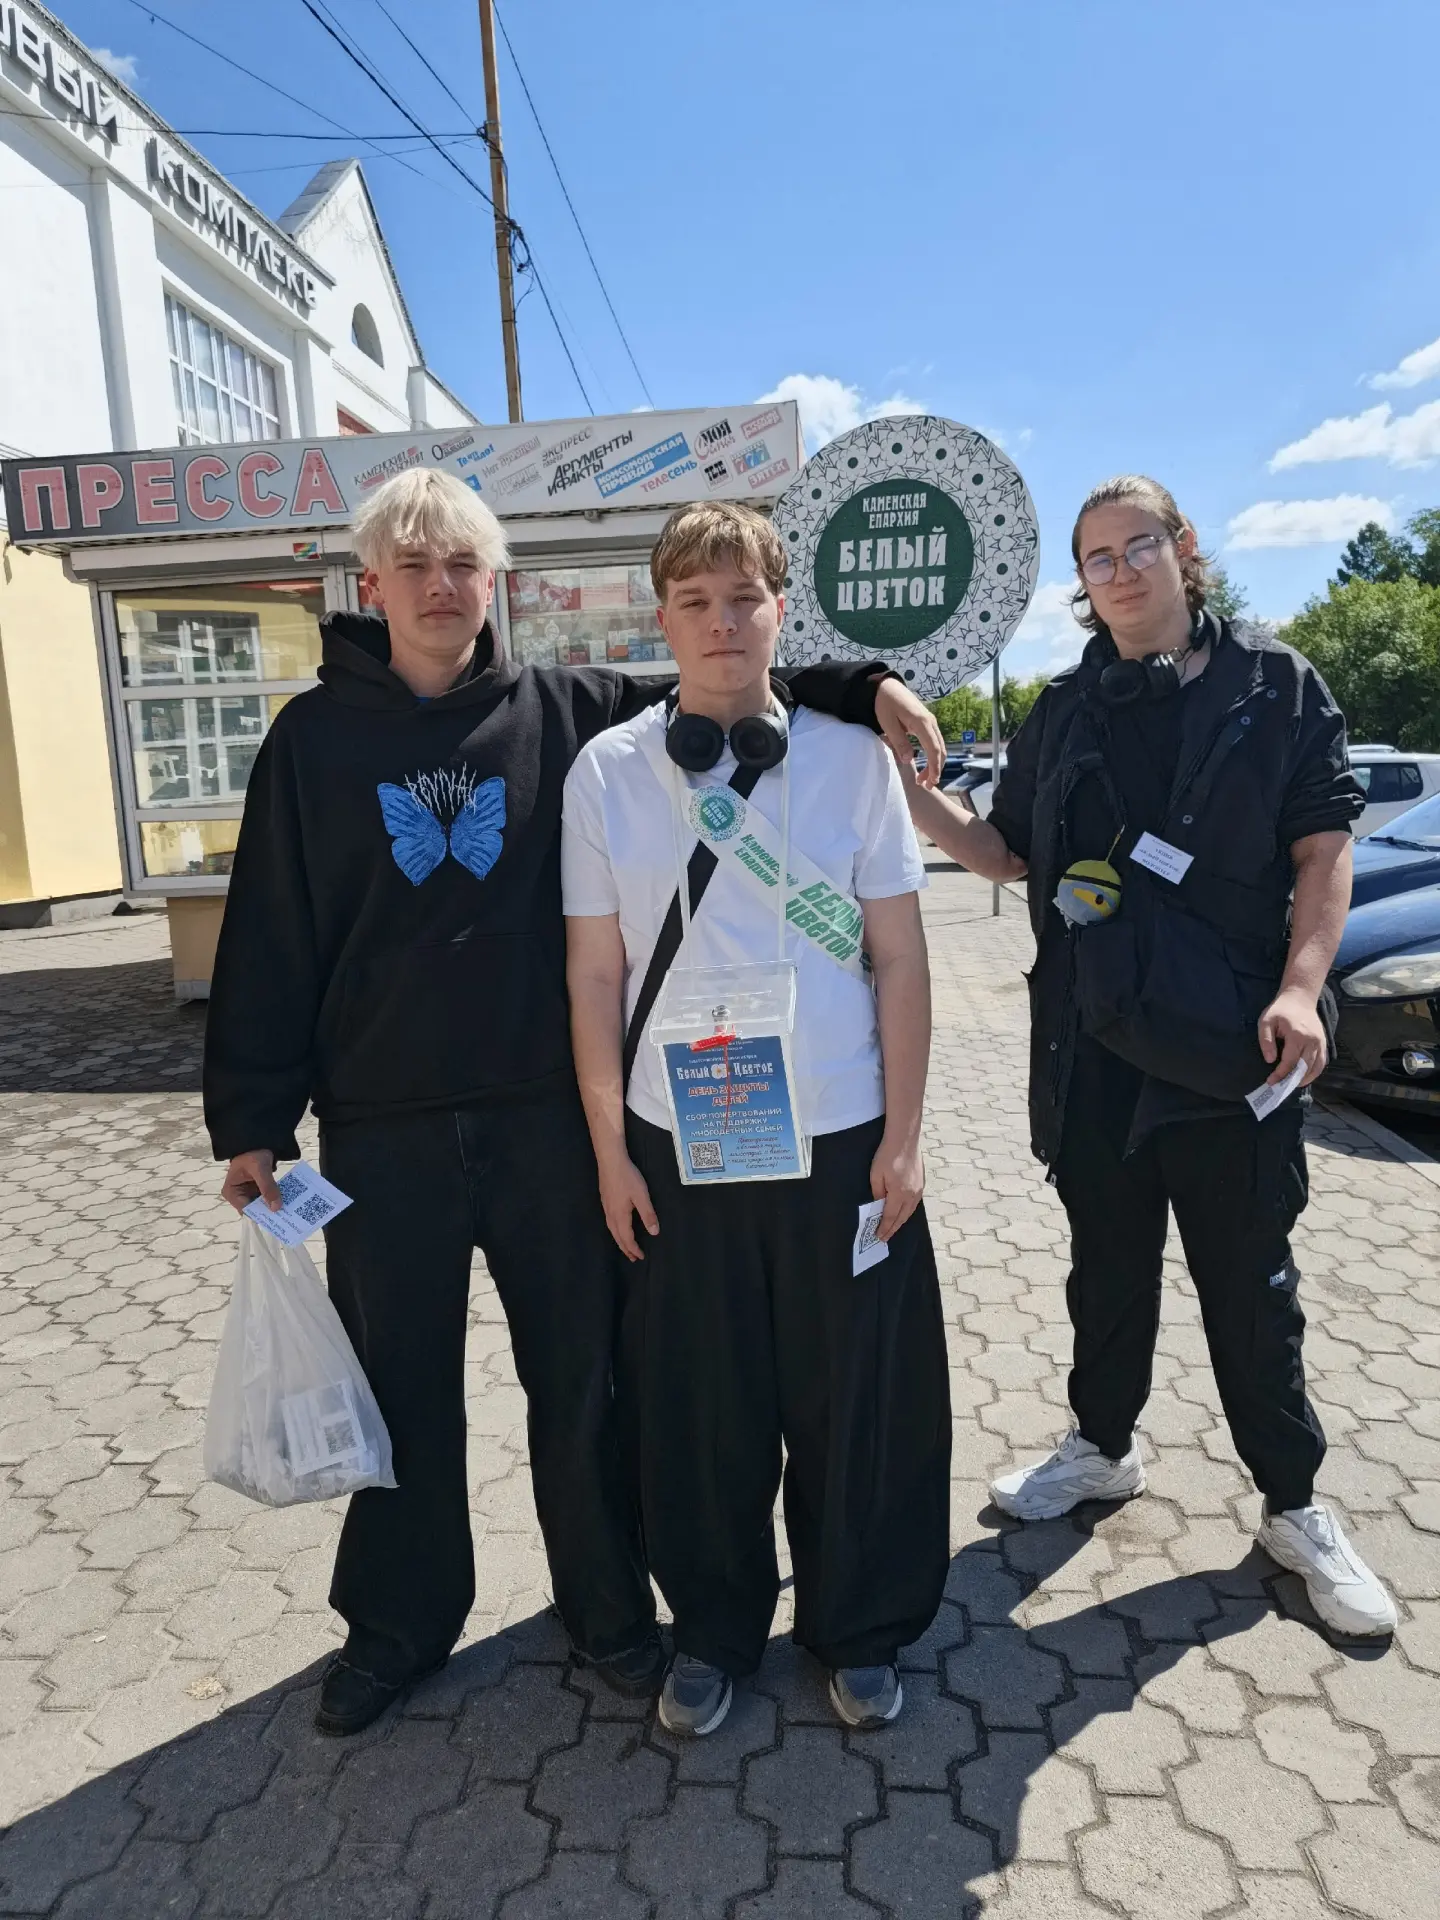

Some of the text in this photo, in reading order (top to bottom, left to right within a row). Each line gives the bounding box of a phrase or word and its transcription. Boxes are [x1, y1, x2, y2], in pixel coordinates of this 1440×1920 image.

[147, 136, 318, 311] КОМПЛЕКС
[541, 426, 594, 460] ЭКСПРЕСС
[701, 420, 732, 447] МОЯ
[554, 430, 633, 484] АРГУМЕНТЫ
[598, 436, 684, 484] КОМСОМОЛЬСКАЯ
[18, 448, 348, 532] ПРЕССА
[600, 460, 656, 494] ПРАВДА
[862, 492, 927, 513] КАМЕНСКАЯ
[868, 509, 920, 530] ЕПАРХИЯ
[838, 525, 948, 573] БЕЛЫЙ
[836, 575, 946, 613] ЦВЕТОК
[688, 1085, 719, 1098] ДЕНЬ
[685, 1113, 707, 1121] СБОР
[755, 1123, 783, 1133] СЕМЕЙ
